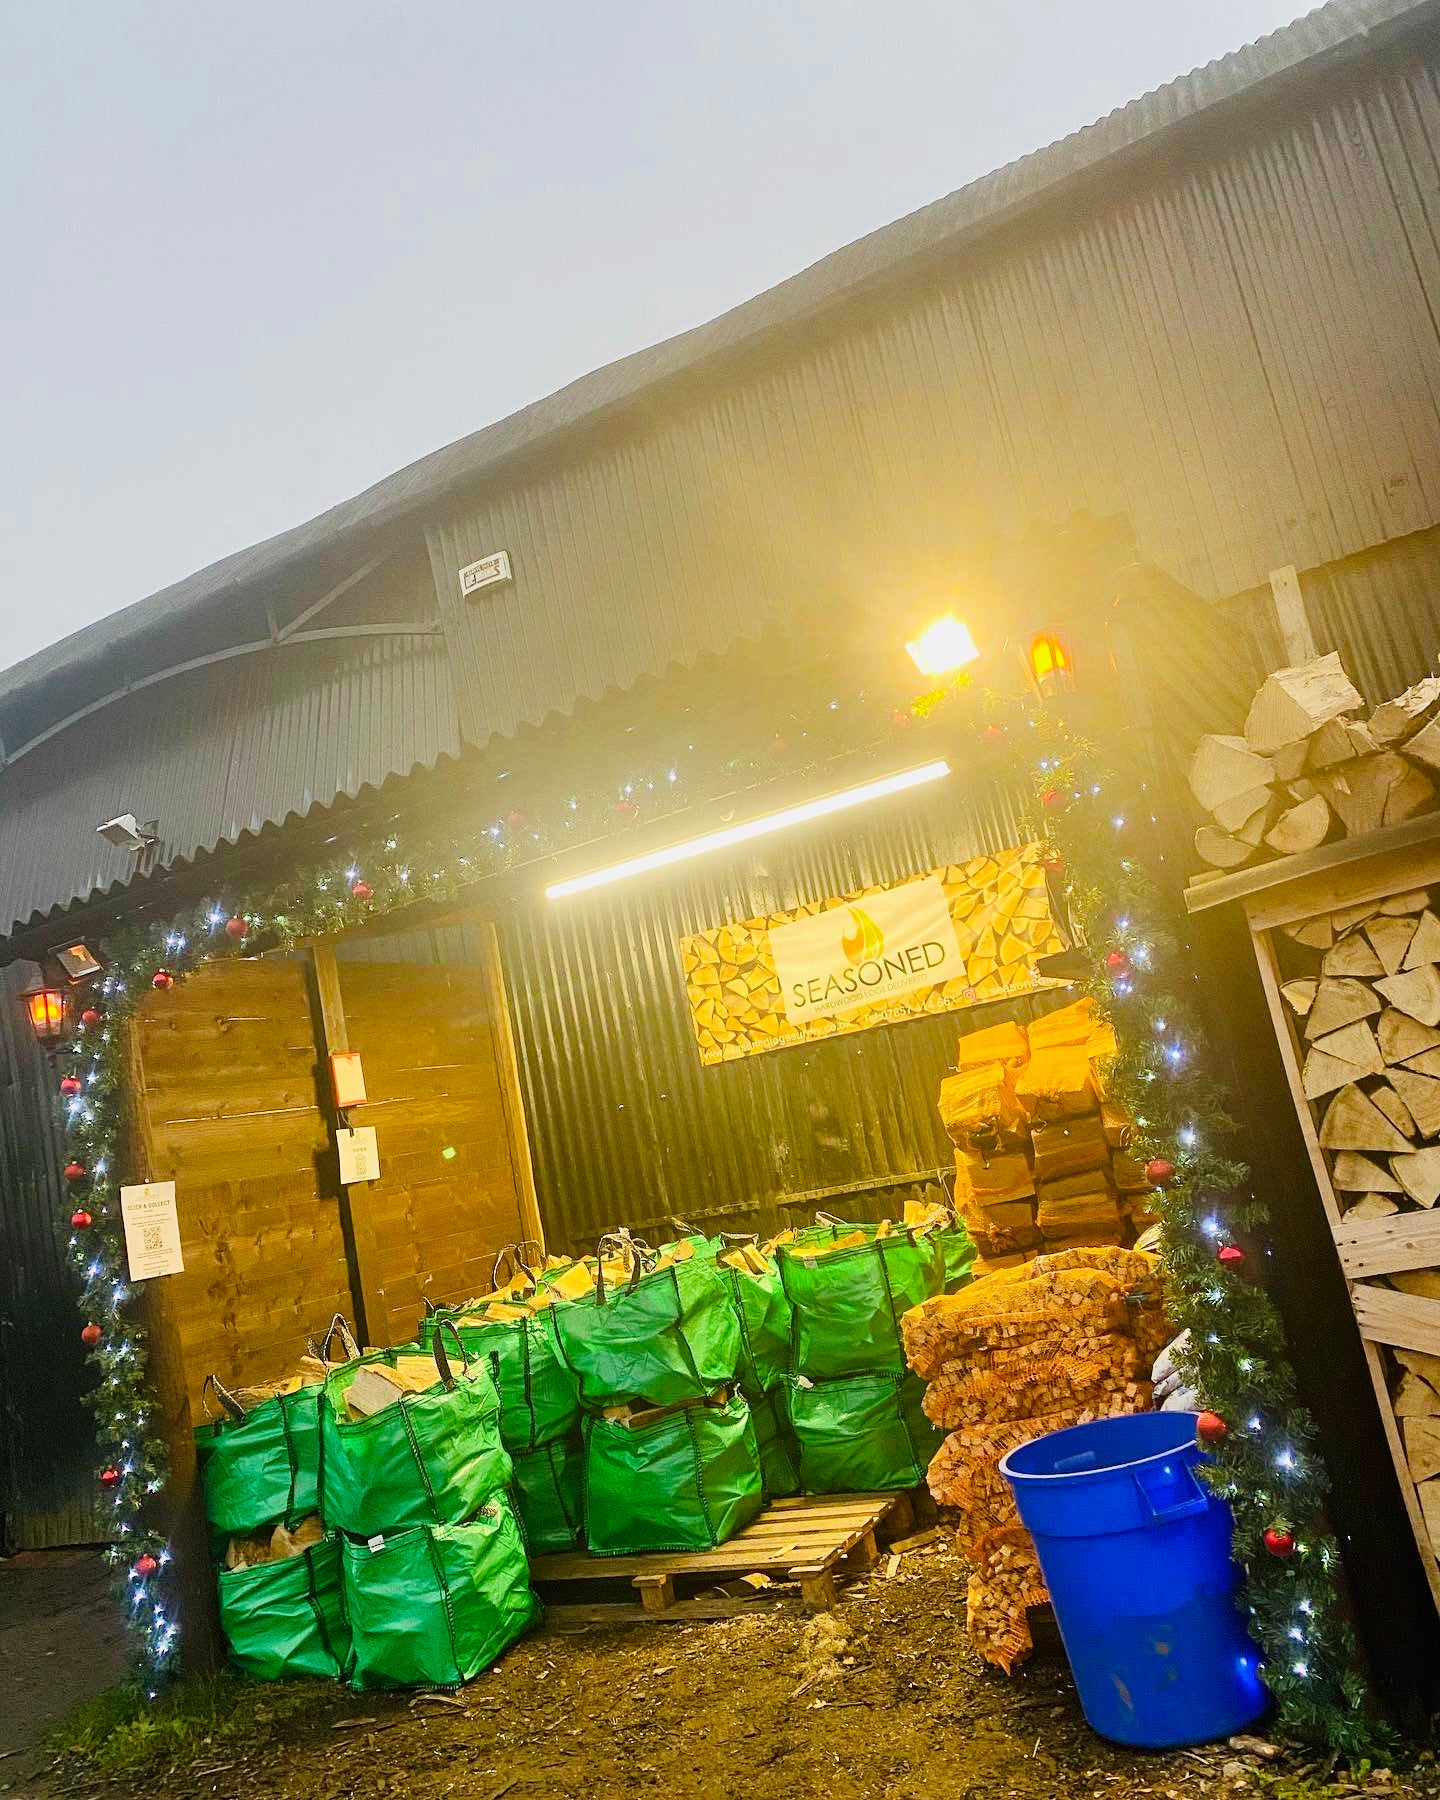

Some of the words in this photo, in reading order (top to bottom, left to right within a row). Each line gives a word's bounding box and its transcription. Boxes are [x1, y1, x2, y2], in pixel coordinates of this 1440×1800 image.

[793, 941, 945, 1008] SEASONED
[814, 993, 864, 1013] HARDWOOD
[864, 986, 887, 999] LOGS
[887, 973, 928, 993] DELIVERED
[148, 1200, 170, 1209] COLLECT
